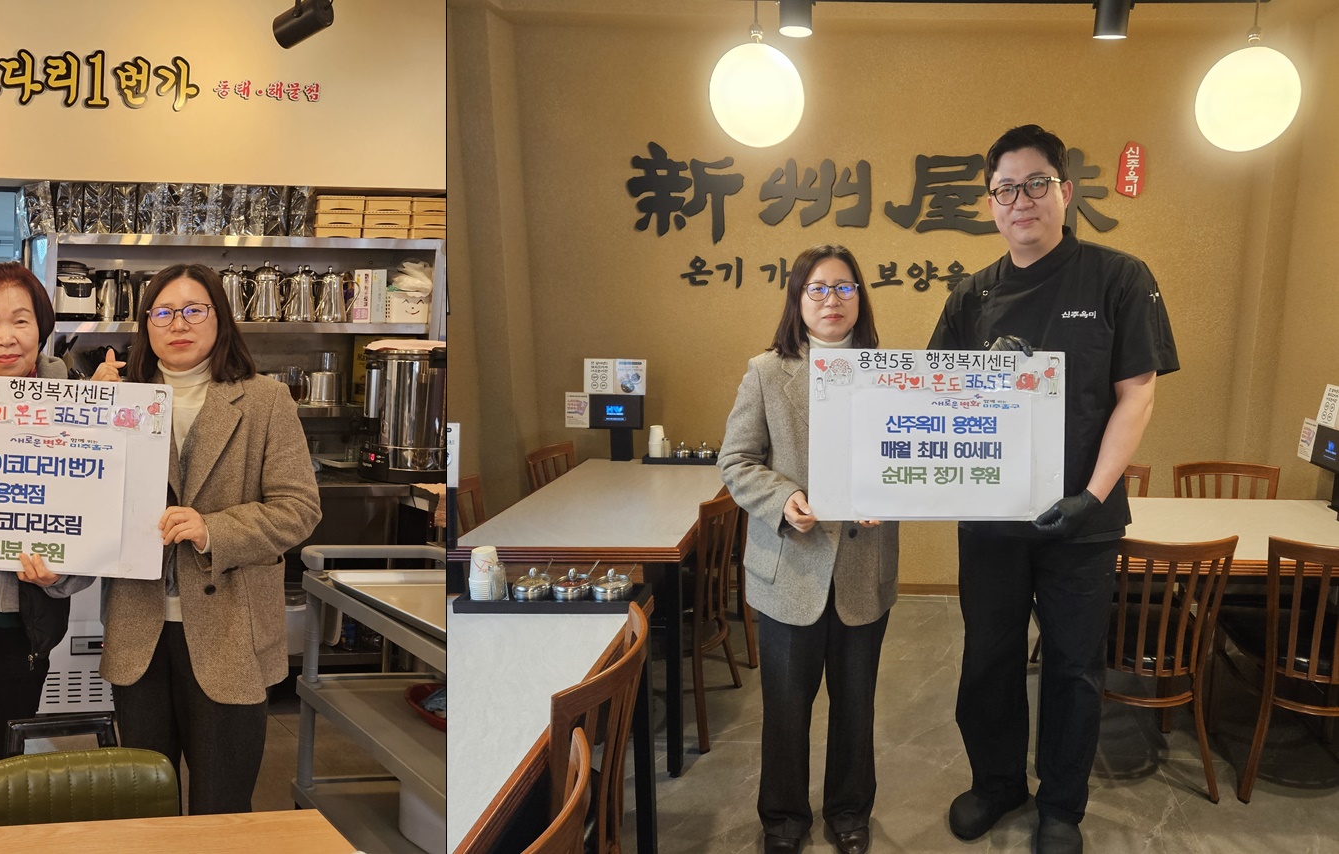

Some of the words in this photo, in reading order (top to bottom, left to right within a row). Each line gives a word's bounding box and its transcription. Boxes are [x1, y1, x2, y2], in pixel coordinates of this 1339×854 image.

[1124, 145, 1141, 197] 신주옥미
[680, 254, 744, 290] 온기
[857, 351, 915, 370] 용현5동
[925, 352, 1018, 372] 행정복지센터
[9, 379, 117, 406] 행정복지센터
[877, 372, 925, 391] 사랑의
[931, 373, 962, 392] 온도
[13, 404, 50, 427] 온도
[885, 415, 946, 434] 신주옥미
[952, 415, 998, 434] 용현점
[880, 441, 911, 460] 매월
[917, 441, 948, 460] 최대
[953, 441, 1003, 460] 60세대
[881, 466, 928, 485] 순대국
[933, 466, 964, 485] 정기
[969, 466, 1001, 485] 후원
[29, 541, 66, 564] 후원
